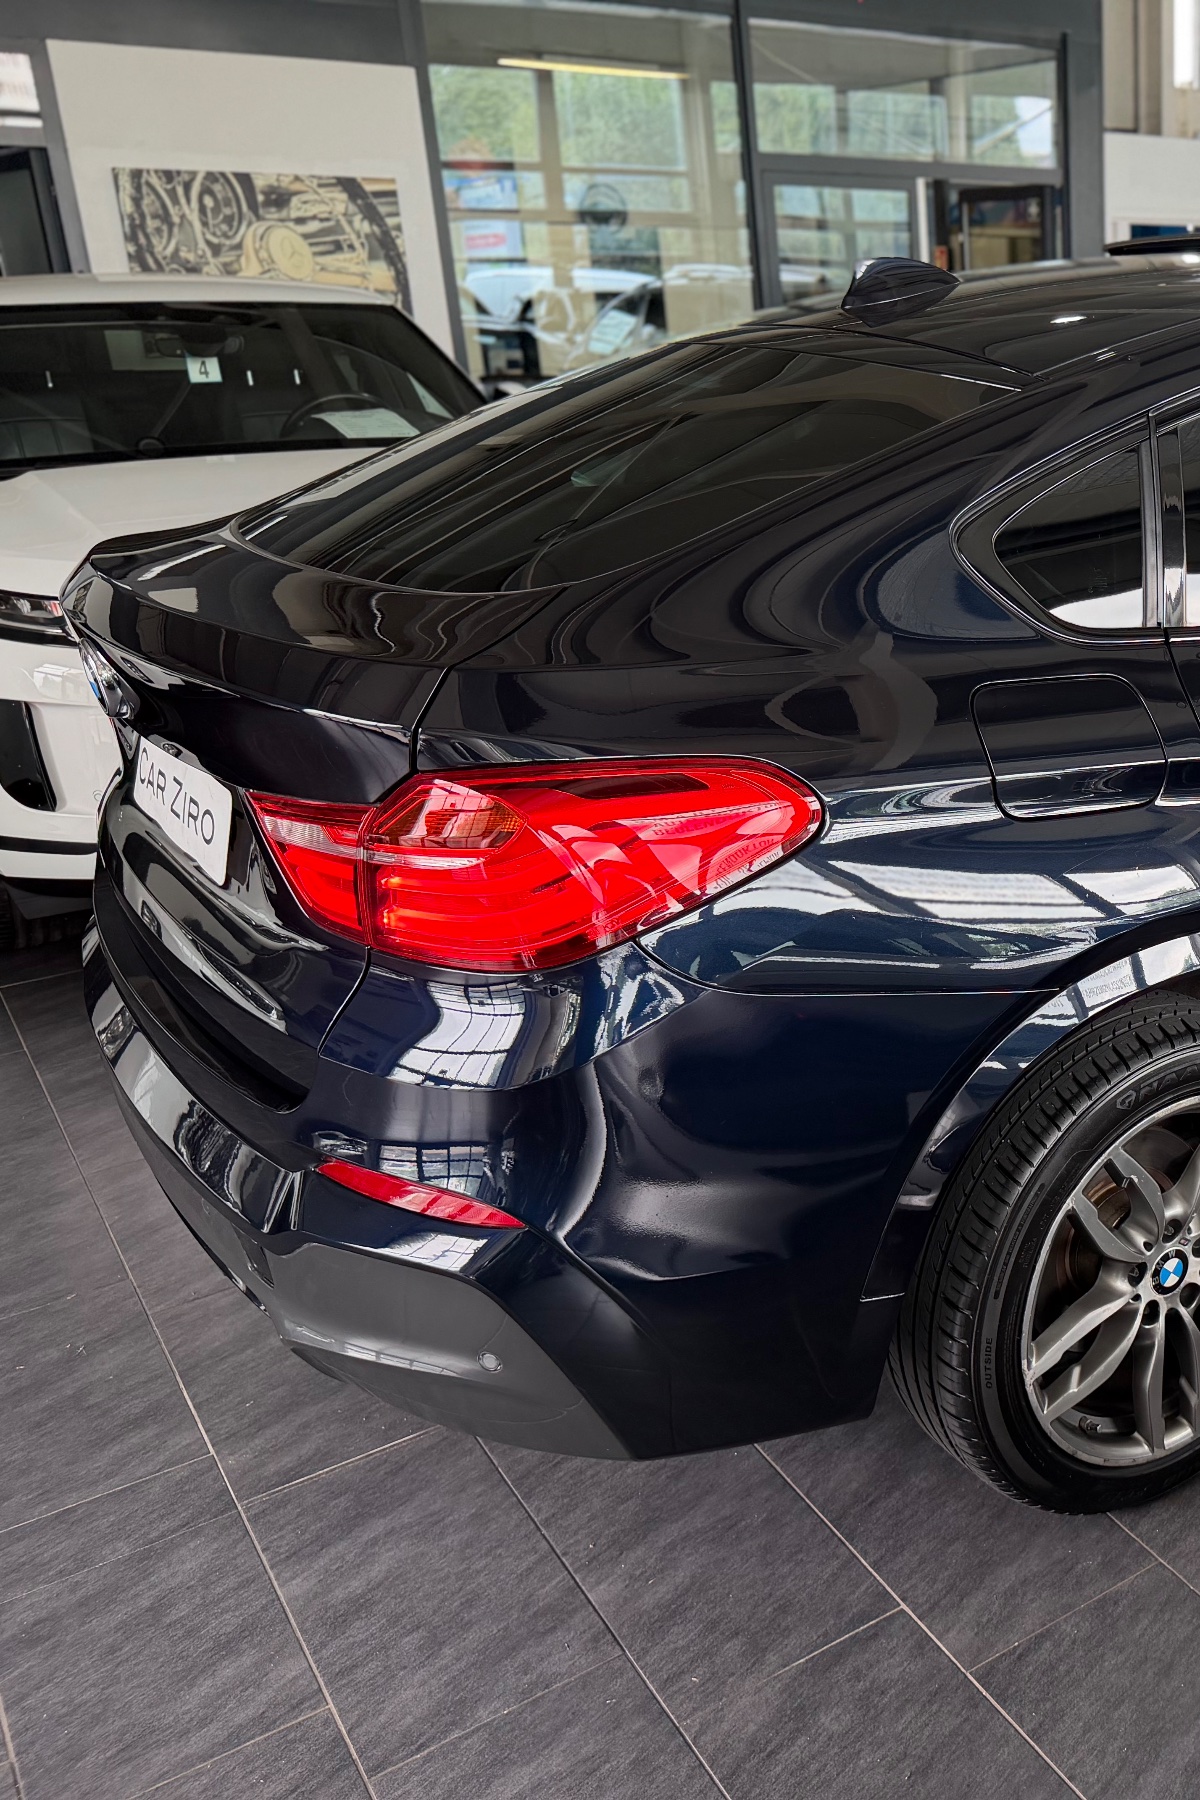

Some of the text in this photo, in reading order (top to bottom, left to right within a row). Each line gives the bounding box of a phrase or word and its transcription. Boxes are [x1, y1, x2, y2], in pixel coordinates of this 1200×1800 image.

[199, 360, 210, 379] 4
[138, 747, 215, 846] CAR ZIRO
[985, 1336, 994, 1389] OUTSIDE
